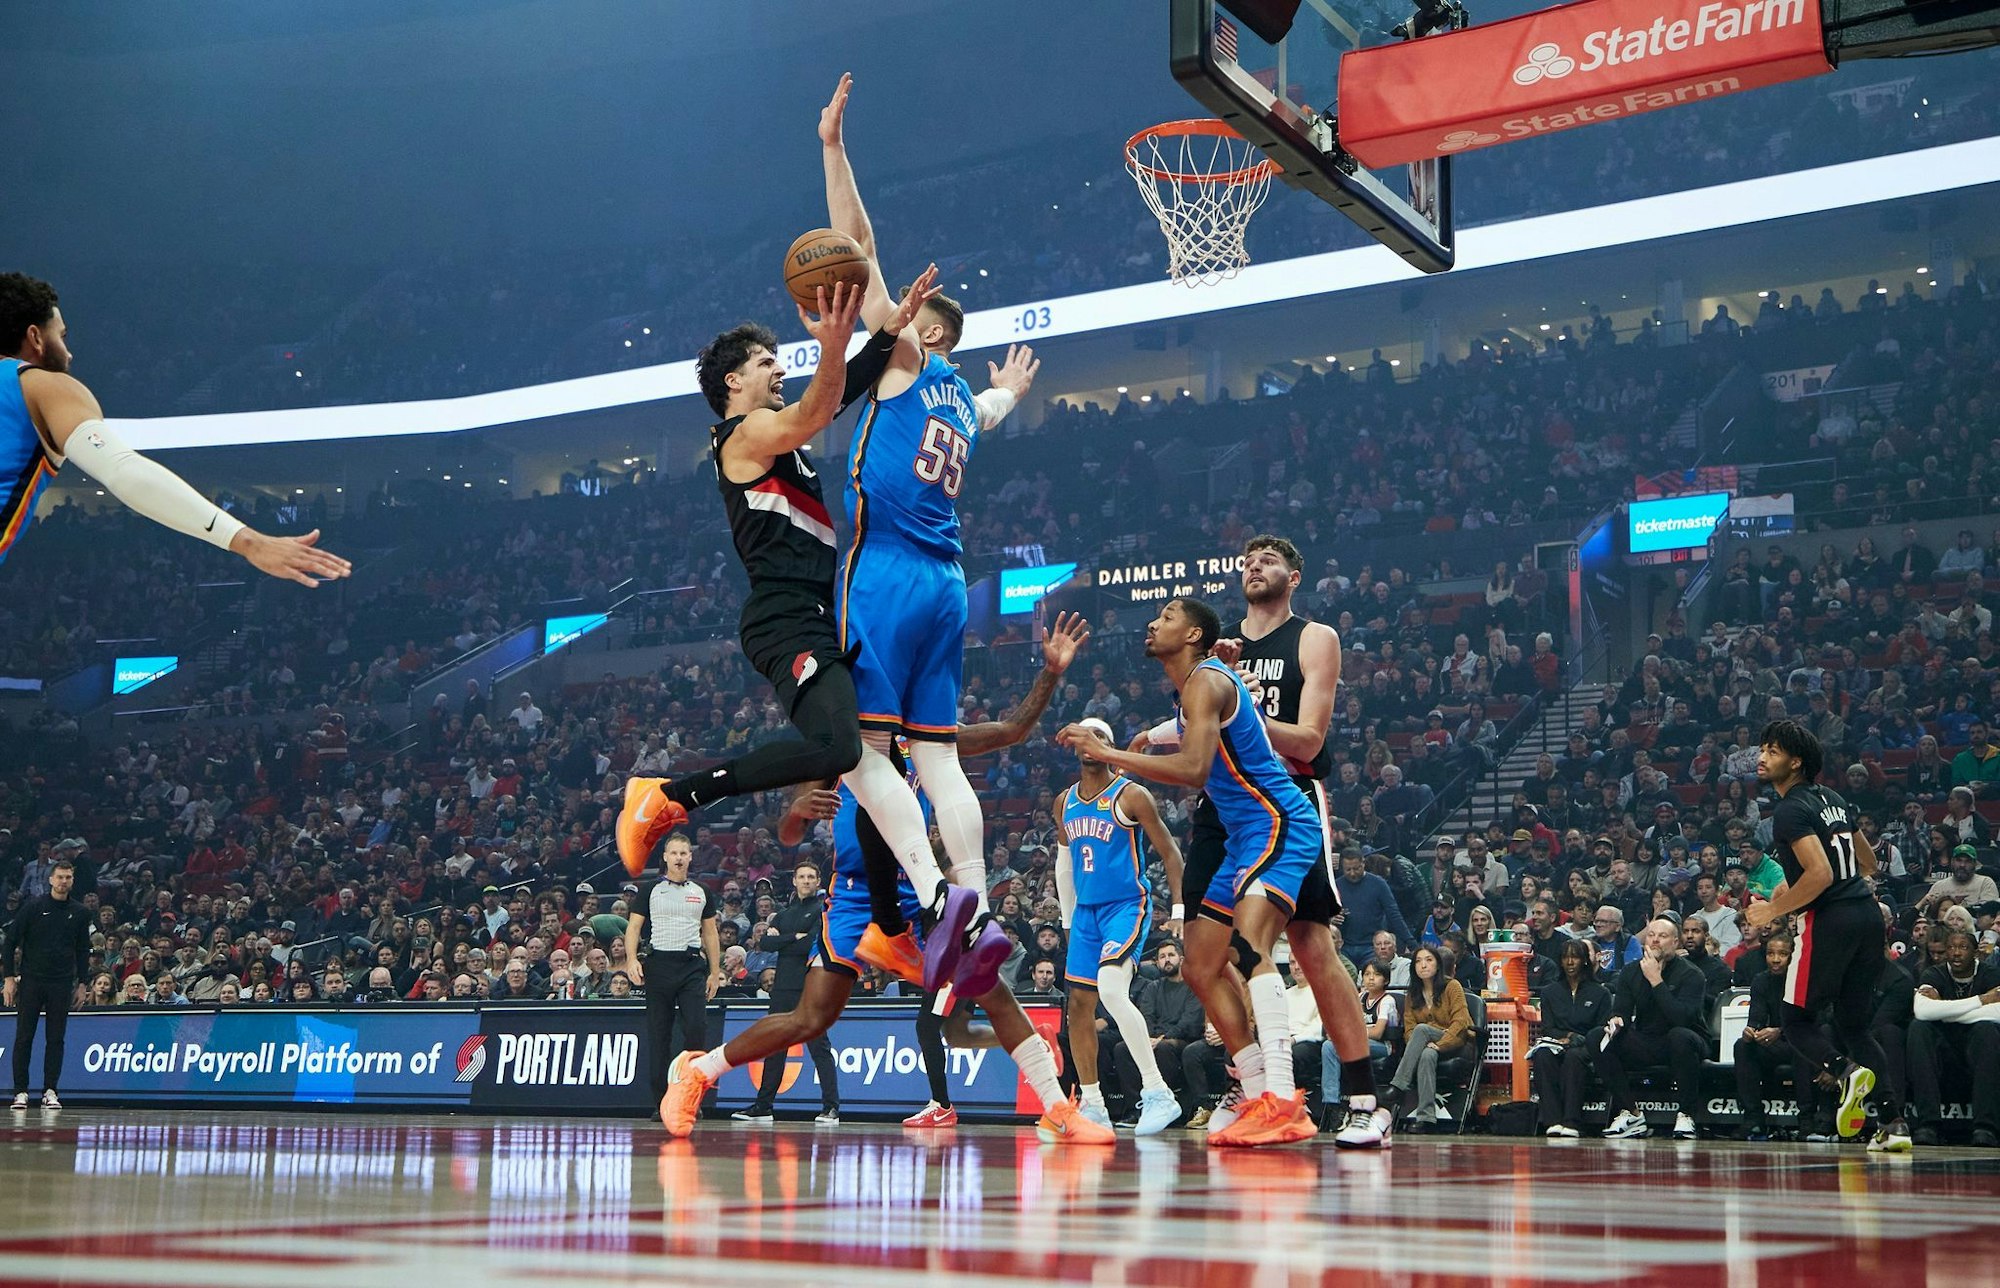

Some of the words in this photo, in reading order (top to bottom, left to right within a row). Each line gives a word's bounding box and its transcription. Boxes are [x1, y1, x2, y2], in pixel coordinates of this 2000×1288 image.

[796, 244, 853, 267] Wilson
[1014, 306, 1051, 333] :03
[786, 345, 819, 369] :03
[1767, 374, 1796, 389] 201
[914, 414, 971, 498] 55
[1098, 562, 1186, 586] DAIMLER
[1131, 585, 1168, 601] North
[1173, 581, 1226, 598] Amica
[1064, 816, 1114, 842] THUNDER
[1082, 845, 1094, 872] 2
[1831, 832, 1857, 880] 17
[84, 1042, 179, 1073] Official
[182, 1042, 276, 1082] Payroll
[280, 1042, 403, 1074] Platform
[409, 1042, 443, 1075] of
[495, 1033, 639, 1086] PORTLAND
[813, 1035, 988, 1087] ayloity
